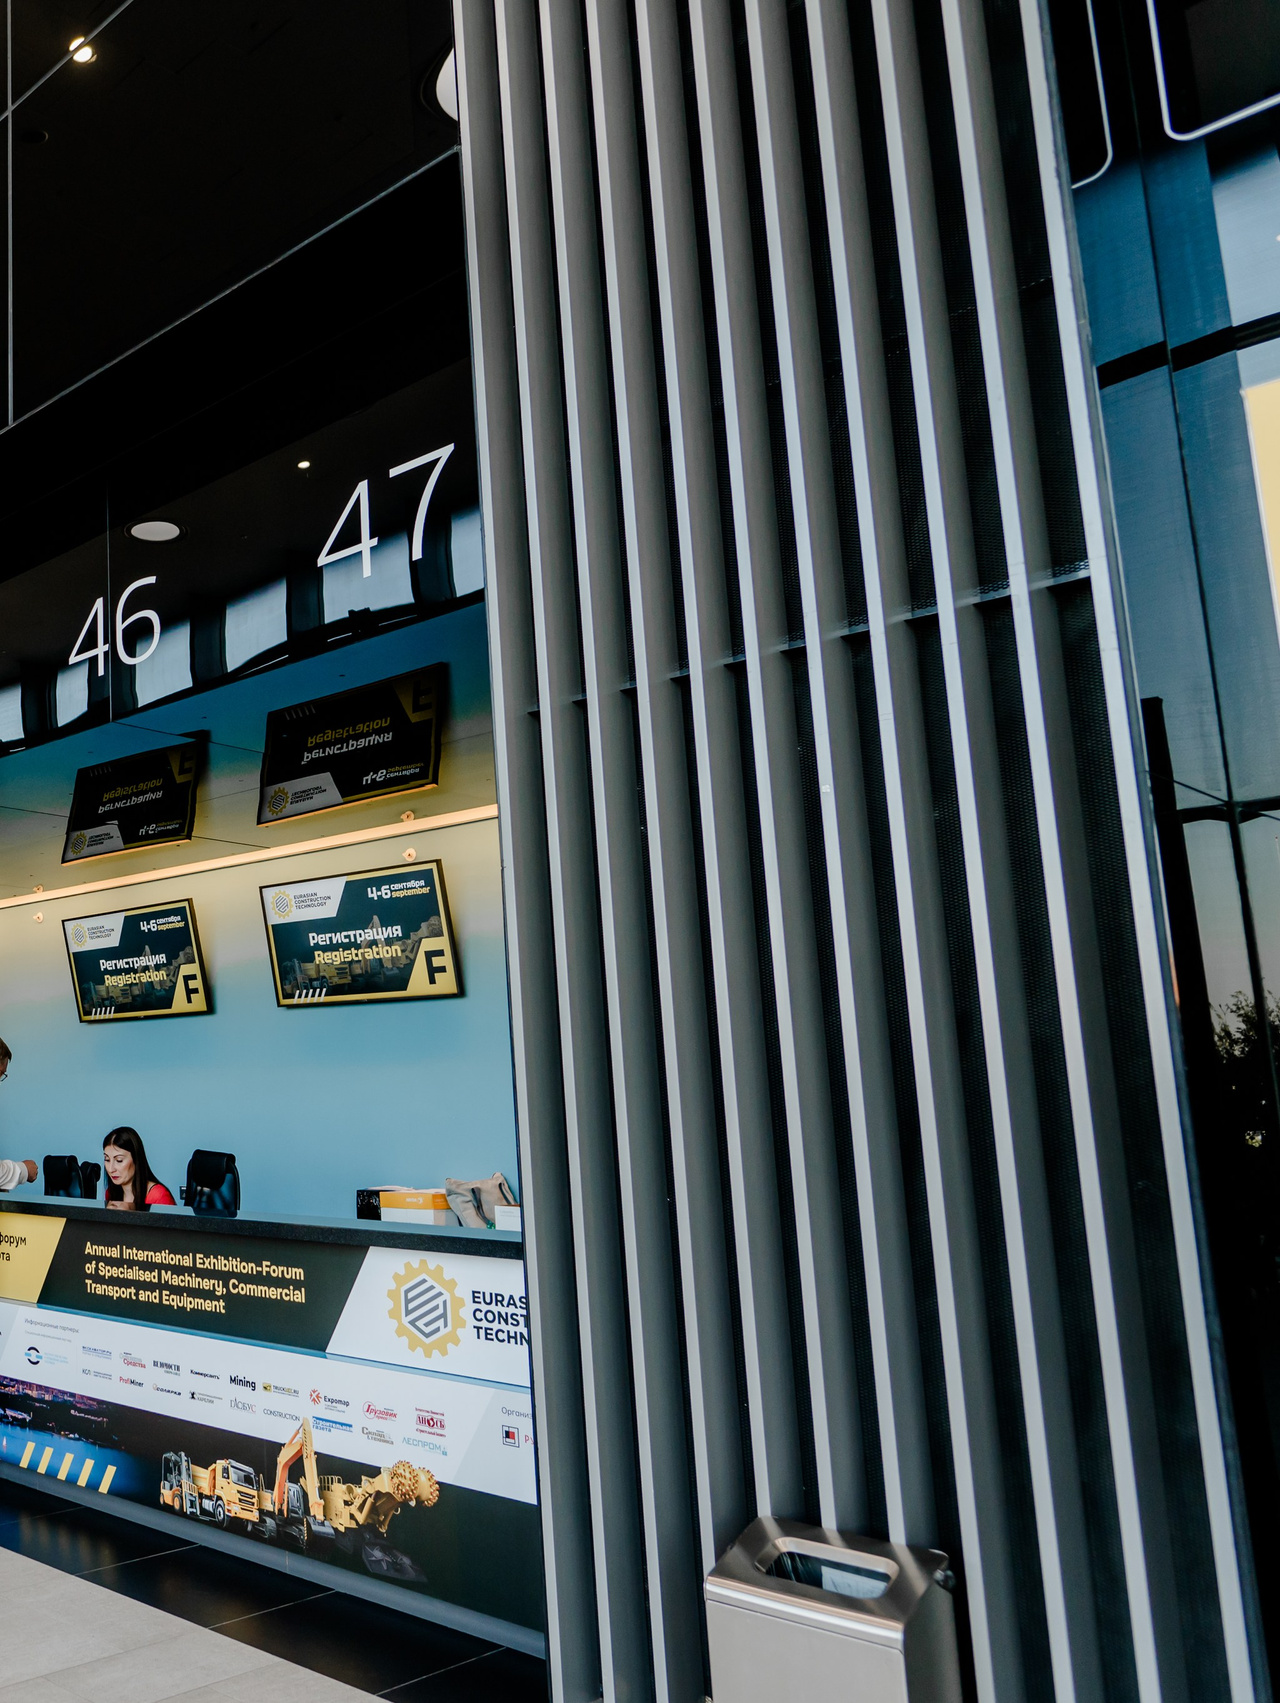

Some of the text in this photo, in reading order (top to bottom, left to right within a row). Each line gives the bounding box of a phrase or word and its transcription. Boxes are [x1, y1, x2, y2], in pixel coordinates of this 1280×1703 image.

[317, 442, 455, 578] 47
[69, 576, 161, 677] 46
[293, 892, 318, 900] EURASIAN
[367, 879, 425, 900] 4-6 сентября
[392, 886, 430, 898] september
[294, 895, 332, 904] CONSTRUCTION
[295, 901, 327, 910] TECHNOLOGY
[140, 920, 157, 932] 4-6
[308, 925, 402, 946] Регистрация
[99, 954, 167, 971] Регистрация
[314, 944, 402, 965] Registration
[424, 949, 447, 985] F
[105, 970, 167, 987] Registration
[183, 974, 199, 1004] F
[85, 1241, 304, 1281] Annual International Exhibition-Forum
[85, 1260, 306, 1303] of Specialised Machinery, Commercial
[85, 1279, 226, 1314] Transport and Equipment
[119, 1376, 144, 1388] ProfiMiner
[229, 1375, 256, 1392] Mining
[323, 1395, 350, 1407] Expomap
[263, 1408, 300, 1422] CONSTRUCTION
[312, 1425, 332, 1433] газета
[402, 1436, 442, 1452] ЛЕСПРОМ
